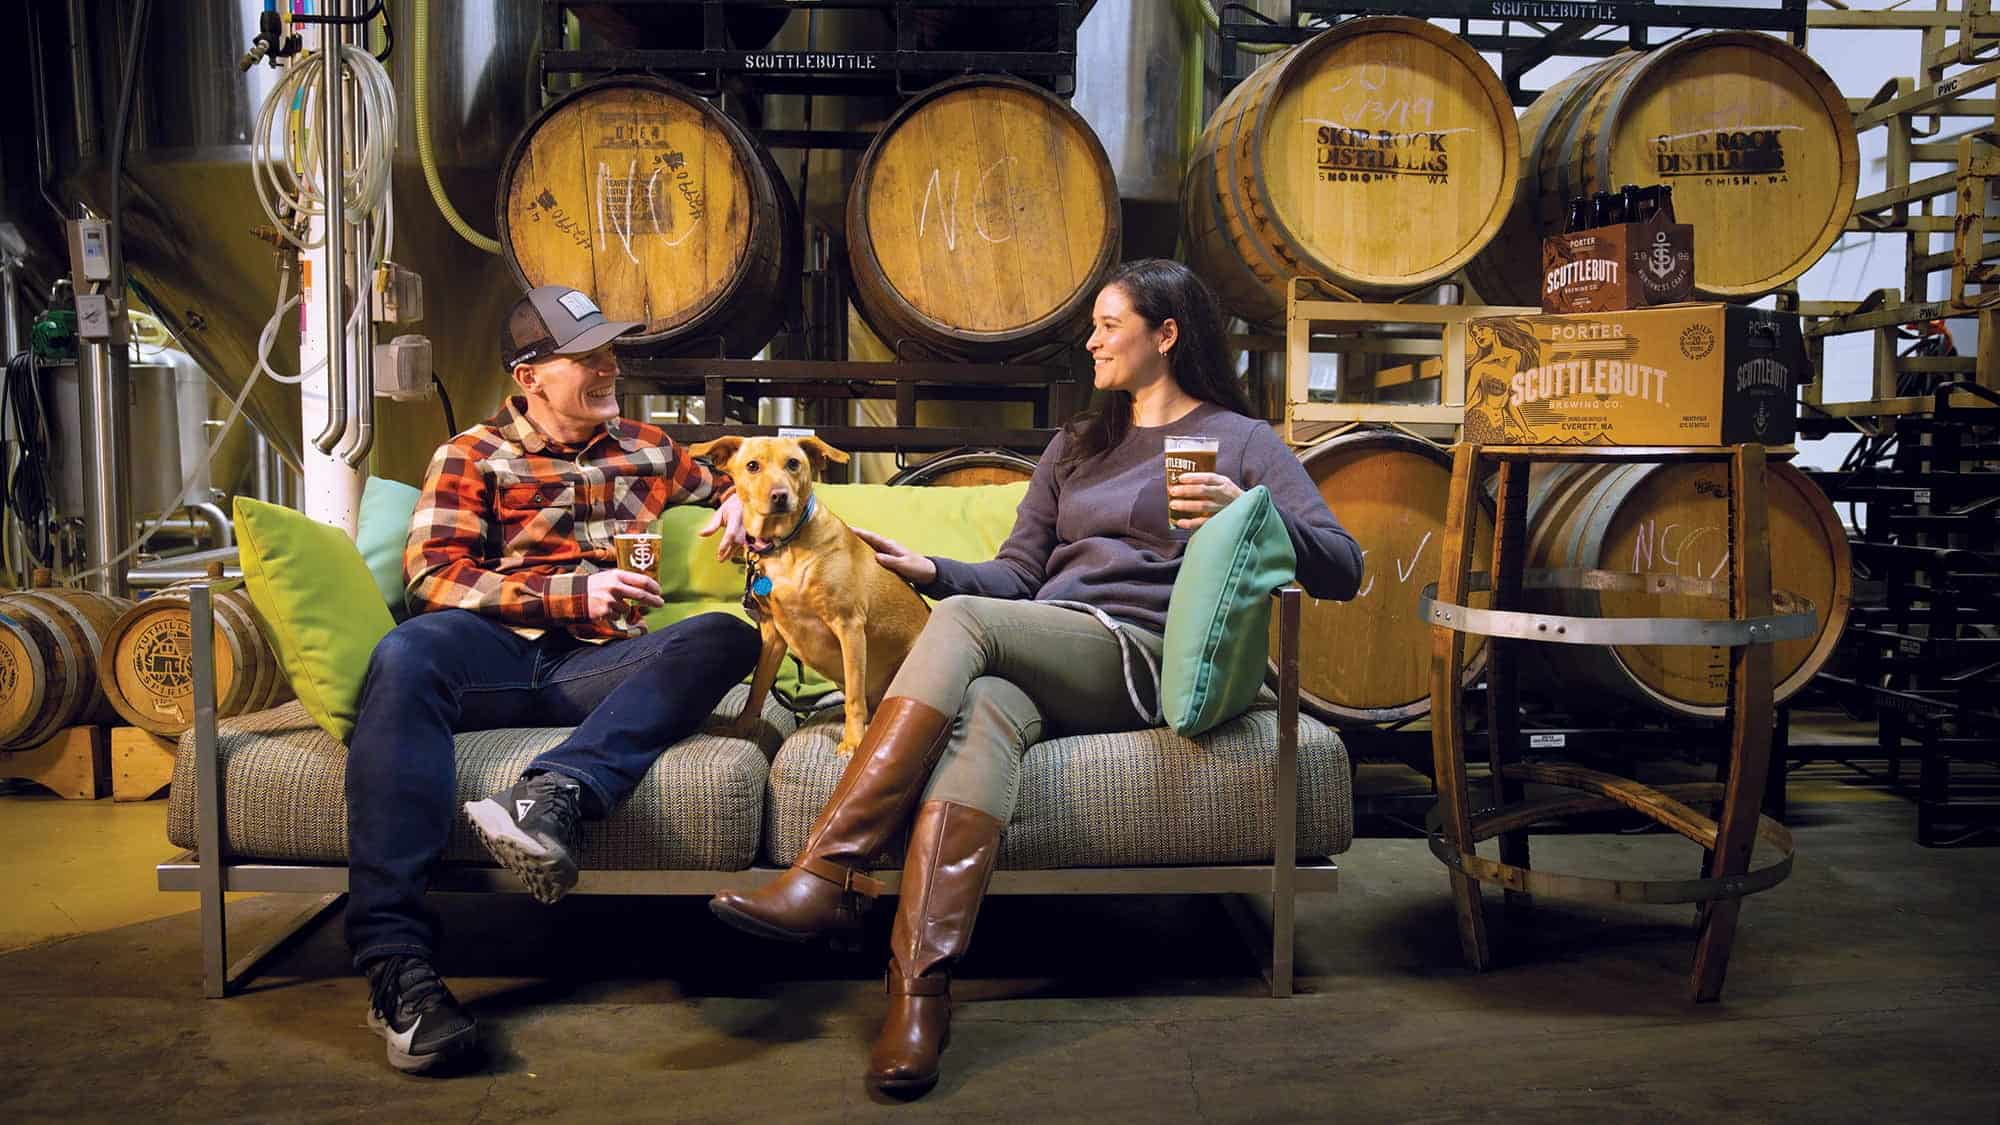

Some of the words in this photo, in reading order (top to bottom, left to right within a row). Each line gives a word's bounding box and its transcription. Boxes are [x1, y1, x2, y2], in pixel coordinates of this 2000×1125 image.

[1491, 1, 1617, 20] SCUTTLEBUTTLE
[744, 54, 877, 69] SCUTTLEBUTTLE
[1376, 129, 1448, 153] ROCK
[1716, 129, 1783, 152] ROCK
[1316, 147, 1448, 172] DISTILLERS
[1427, 175, 1449, 185] WA
[1767, 174, 1789, 184] WA
[1569, 236, 1596, 249] PORTER
[1546, 258, 1619, 294] SCUTTLEBUTT
[1551, 322, 1625, 340] PORTER
[1510, 358, 1669, 408] SCUTTLEBUTT
[1736, 358, 1789, 393] SCUTTLEBUTT
[1549, 400, 1600, 409] BREWING
[143, 675, 191, 696] SPIRIT
